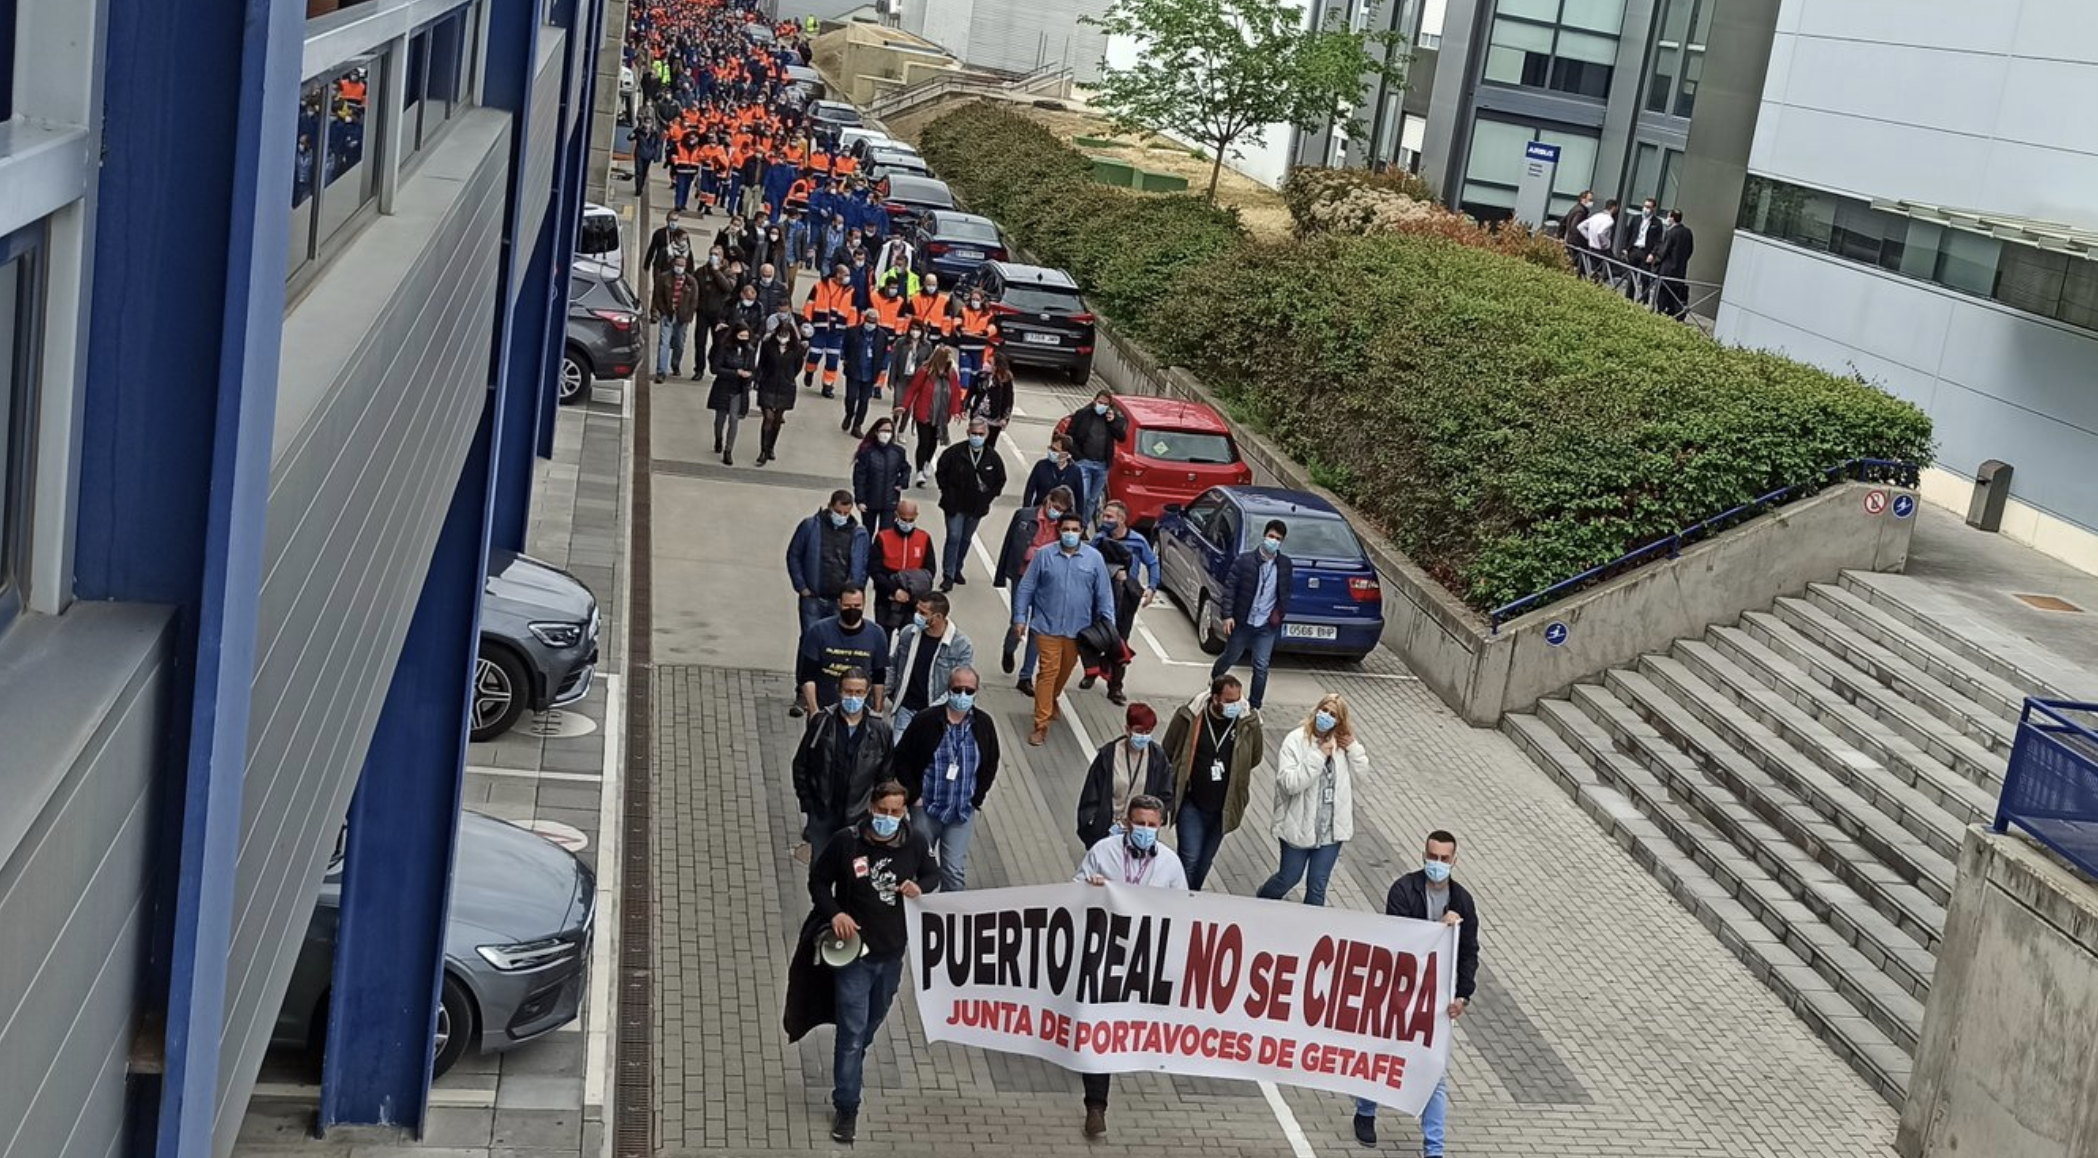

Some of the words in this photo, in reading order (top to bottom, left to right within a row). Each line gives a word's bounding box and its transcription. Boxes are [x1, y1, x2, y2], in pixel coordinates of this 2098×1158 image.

[921, 907, 1074, 993] PUERTO
[1075, 907, 1174, 1006] REAL
[1180, 921, 1243, 1015] NO
[1244, 951, 1299, 1022] SE
[1303, 935, 1437, 1048] CIERRA
[946, 999, 1033, 1036] JUNTA
[1040, 1009, 1072, 1049] DE
[1073, 1021, 1253, 1063] PORTAVOCES
[1257, 1036, 1296, 1069] DE
[1301, 1043, 1406, 1090] GETAFE
